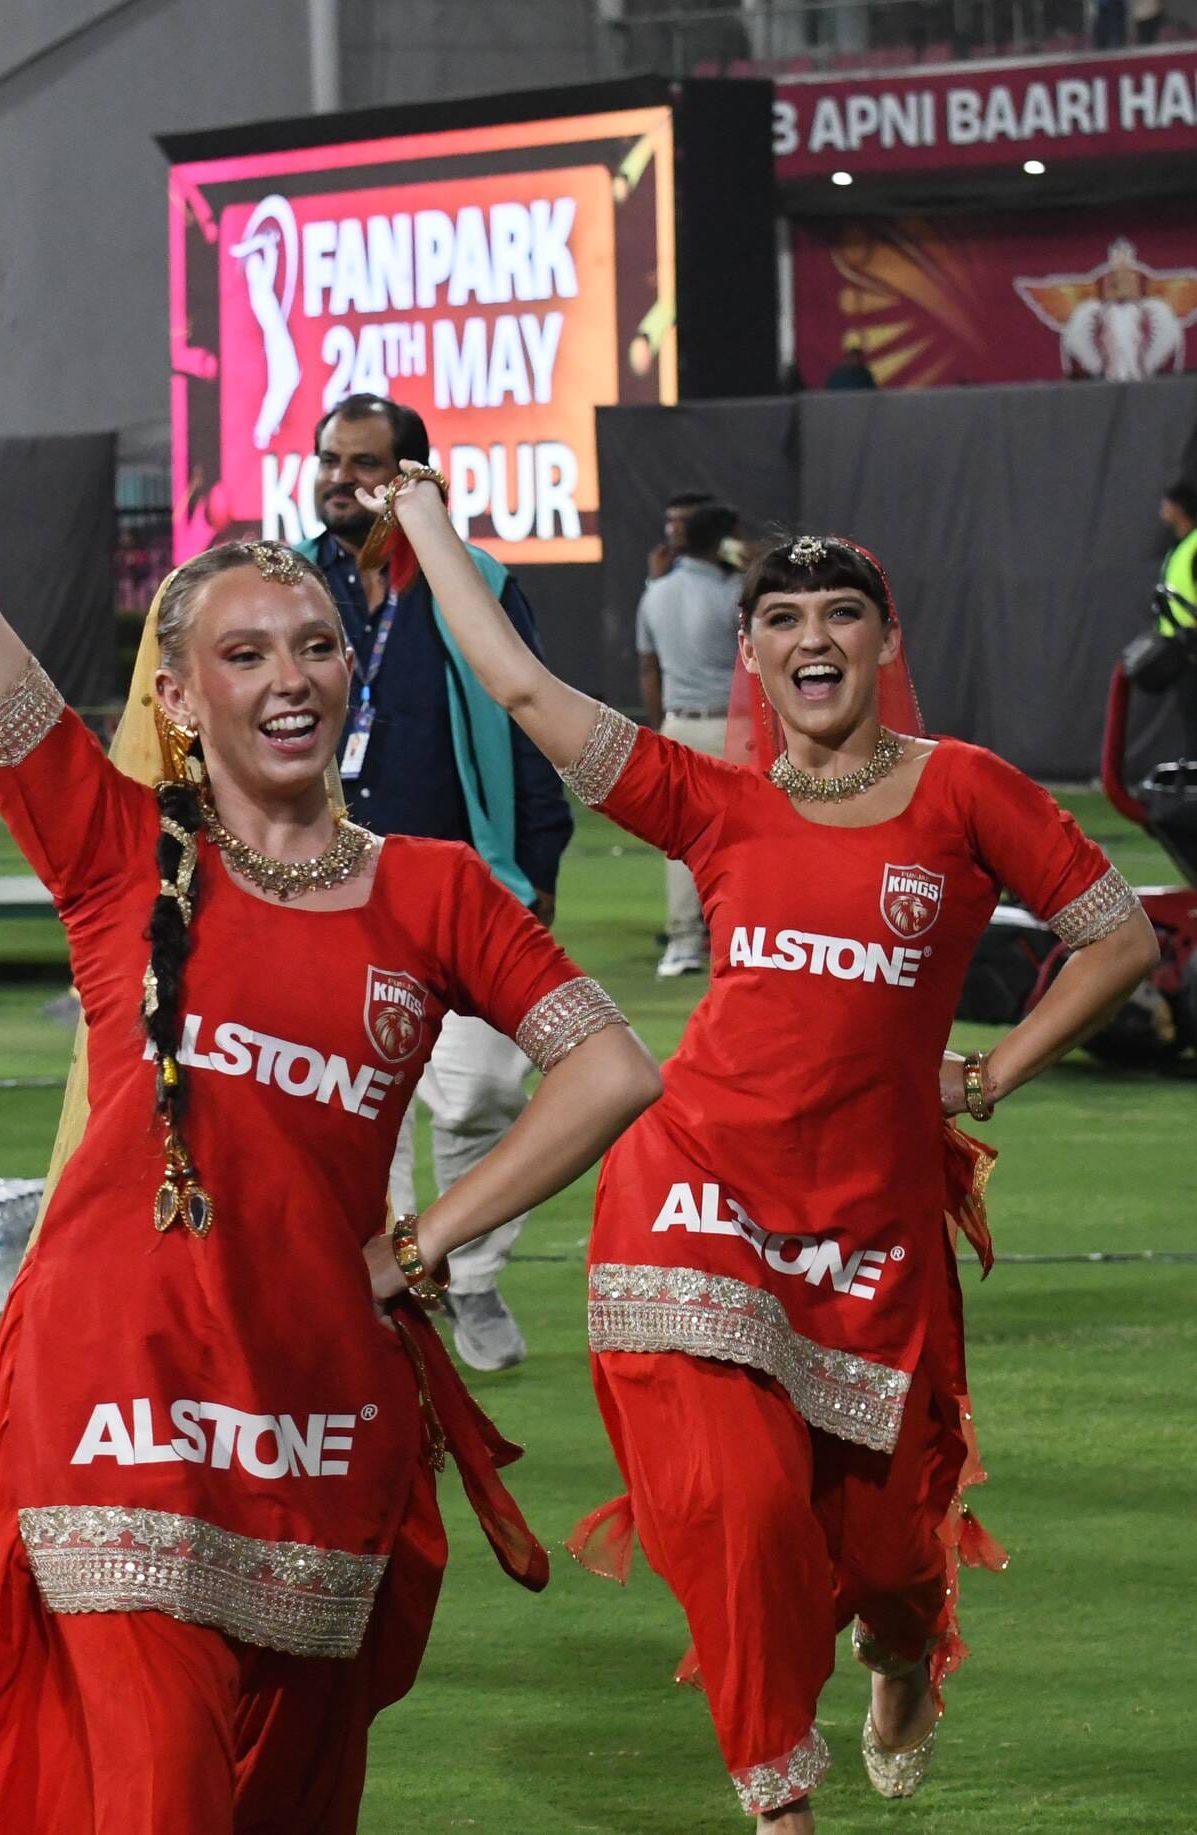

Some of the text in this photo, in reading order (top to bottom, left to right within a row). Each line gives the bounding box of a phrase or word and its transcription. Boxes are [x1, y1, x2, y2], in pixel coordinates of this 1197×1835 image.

[808, 90, 936, 153] APNI
[946, 76, 1107, 145] BAARI
[1118, 69, 1197, 132] HA
[303, 197, 579, 317] FANPARK
[432, 312, 564, 409] MAY
[887, 875, 939, 903] KINGS
[373, 981, 423, 1020] KINGS
